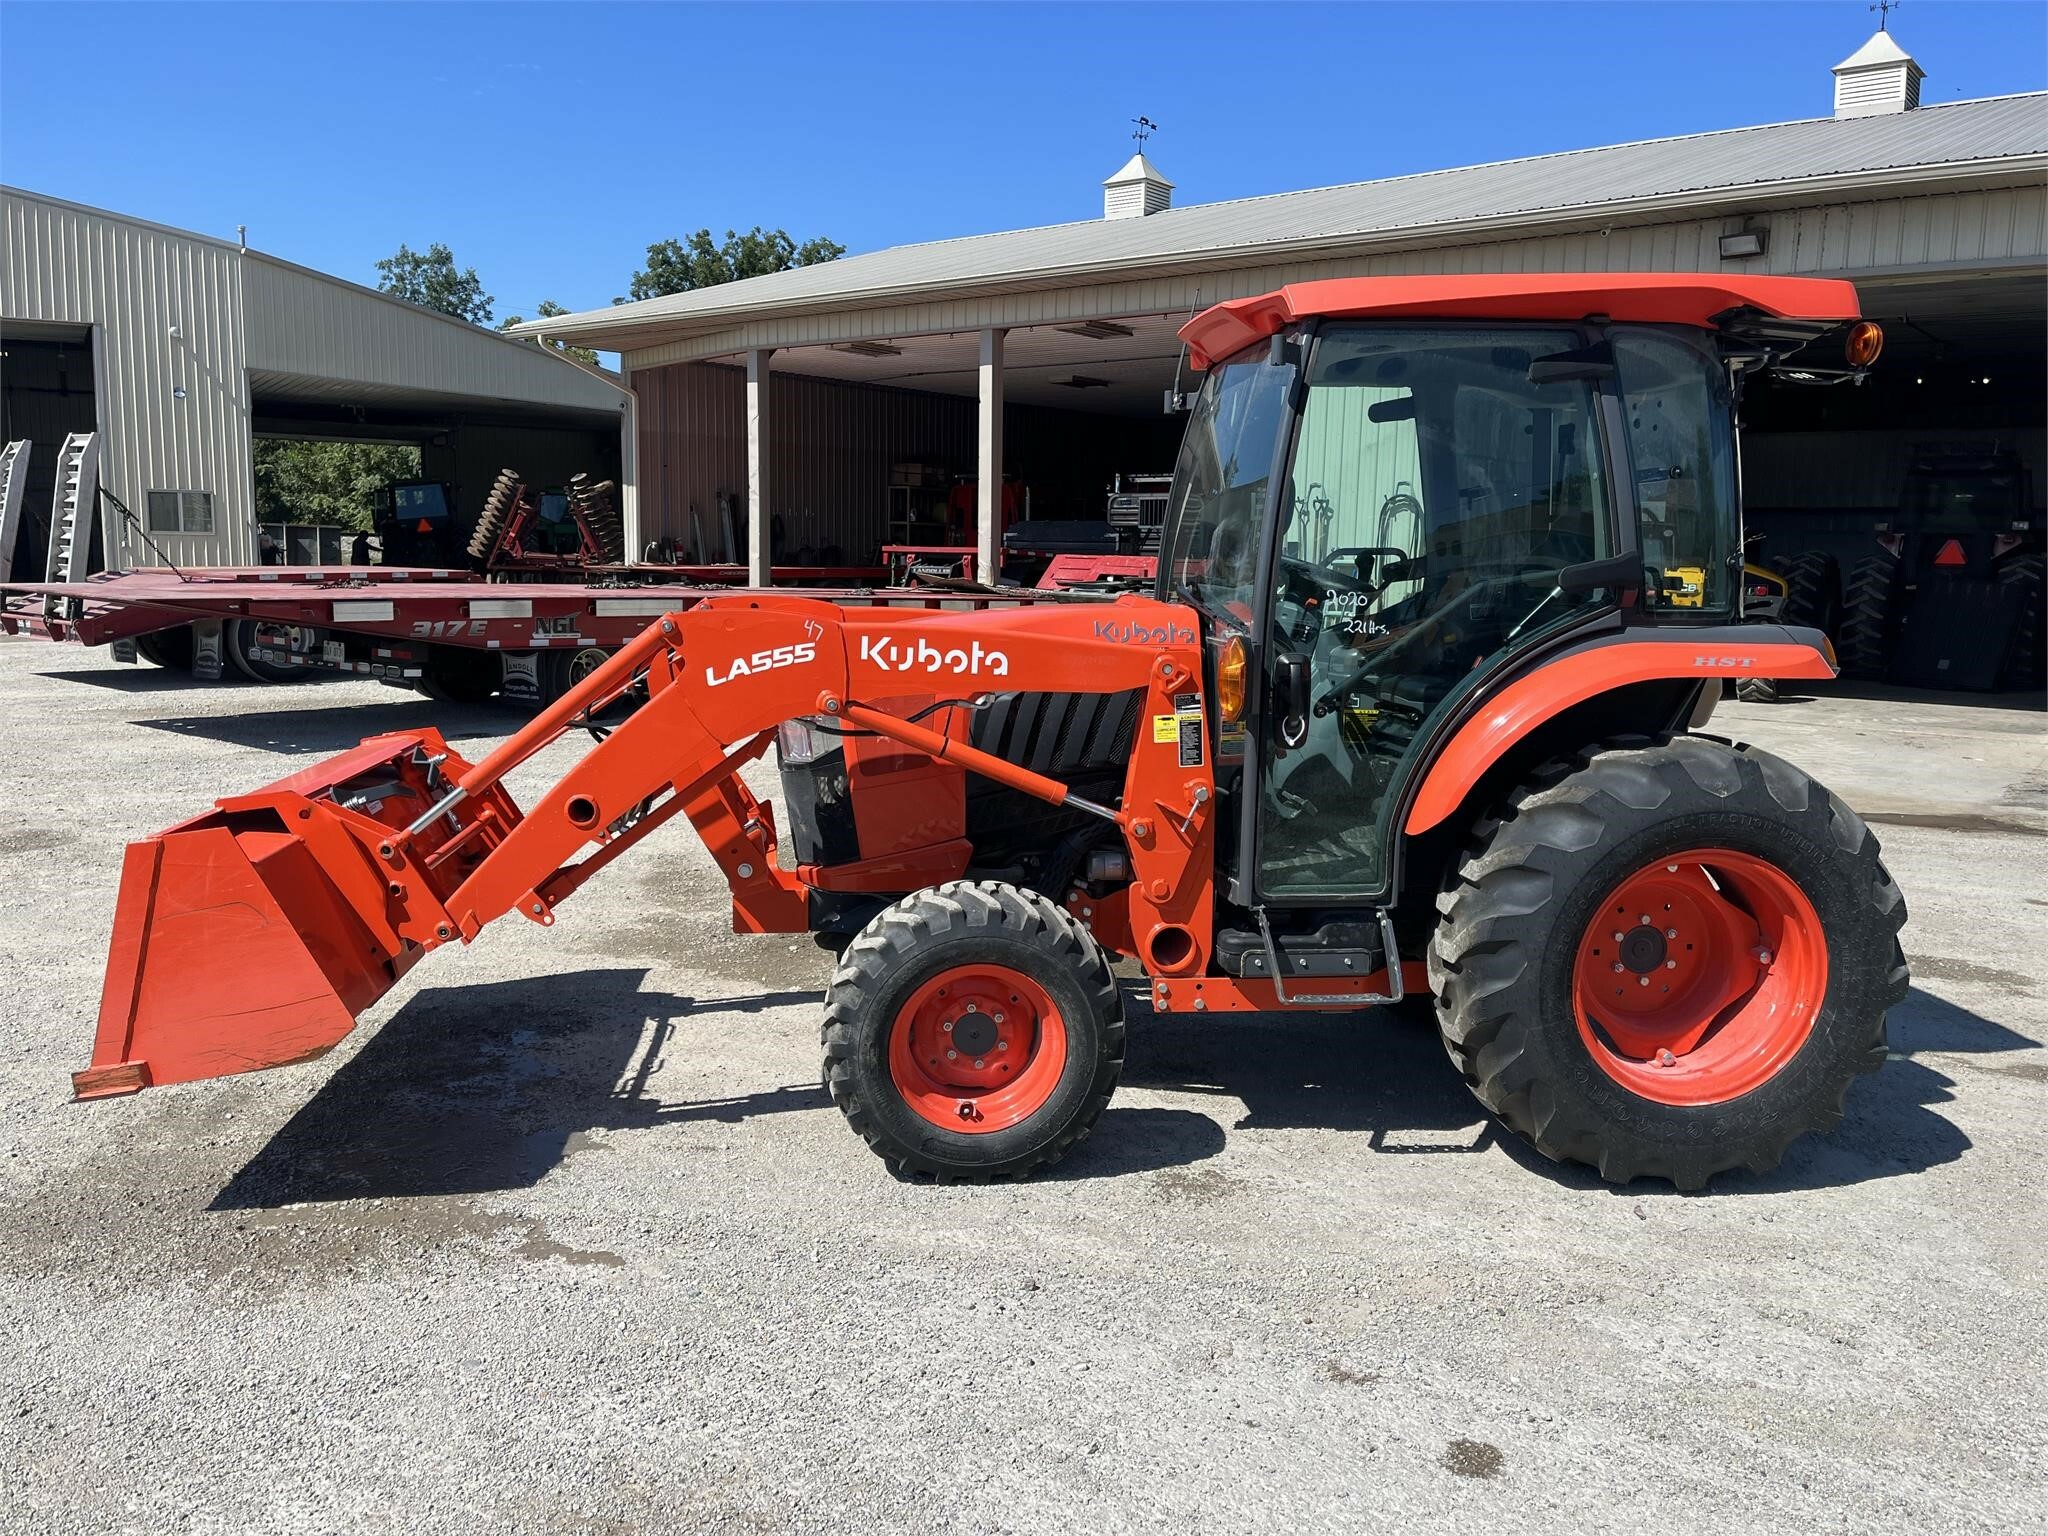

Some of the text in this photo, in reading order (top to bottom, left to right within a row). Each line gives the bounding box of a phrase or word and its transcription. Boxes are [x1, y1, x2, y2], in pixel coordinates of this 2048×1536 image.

[1326, 589, 1368, 606] 2020
[1681, 584, 1697, 592] CB
[536, 617, 581, 634] NGL
[804, 620, 824, 641] 47
[1094, 621, 1196, 643] Kubota
[705, 642, 816, 687] LA555
[860, 635, 1009, 676] Kubota
[1693, 656, 1758, 669] HST
